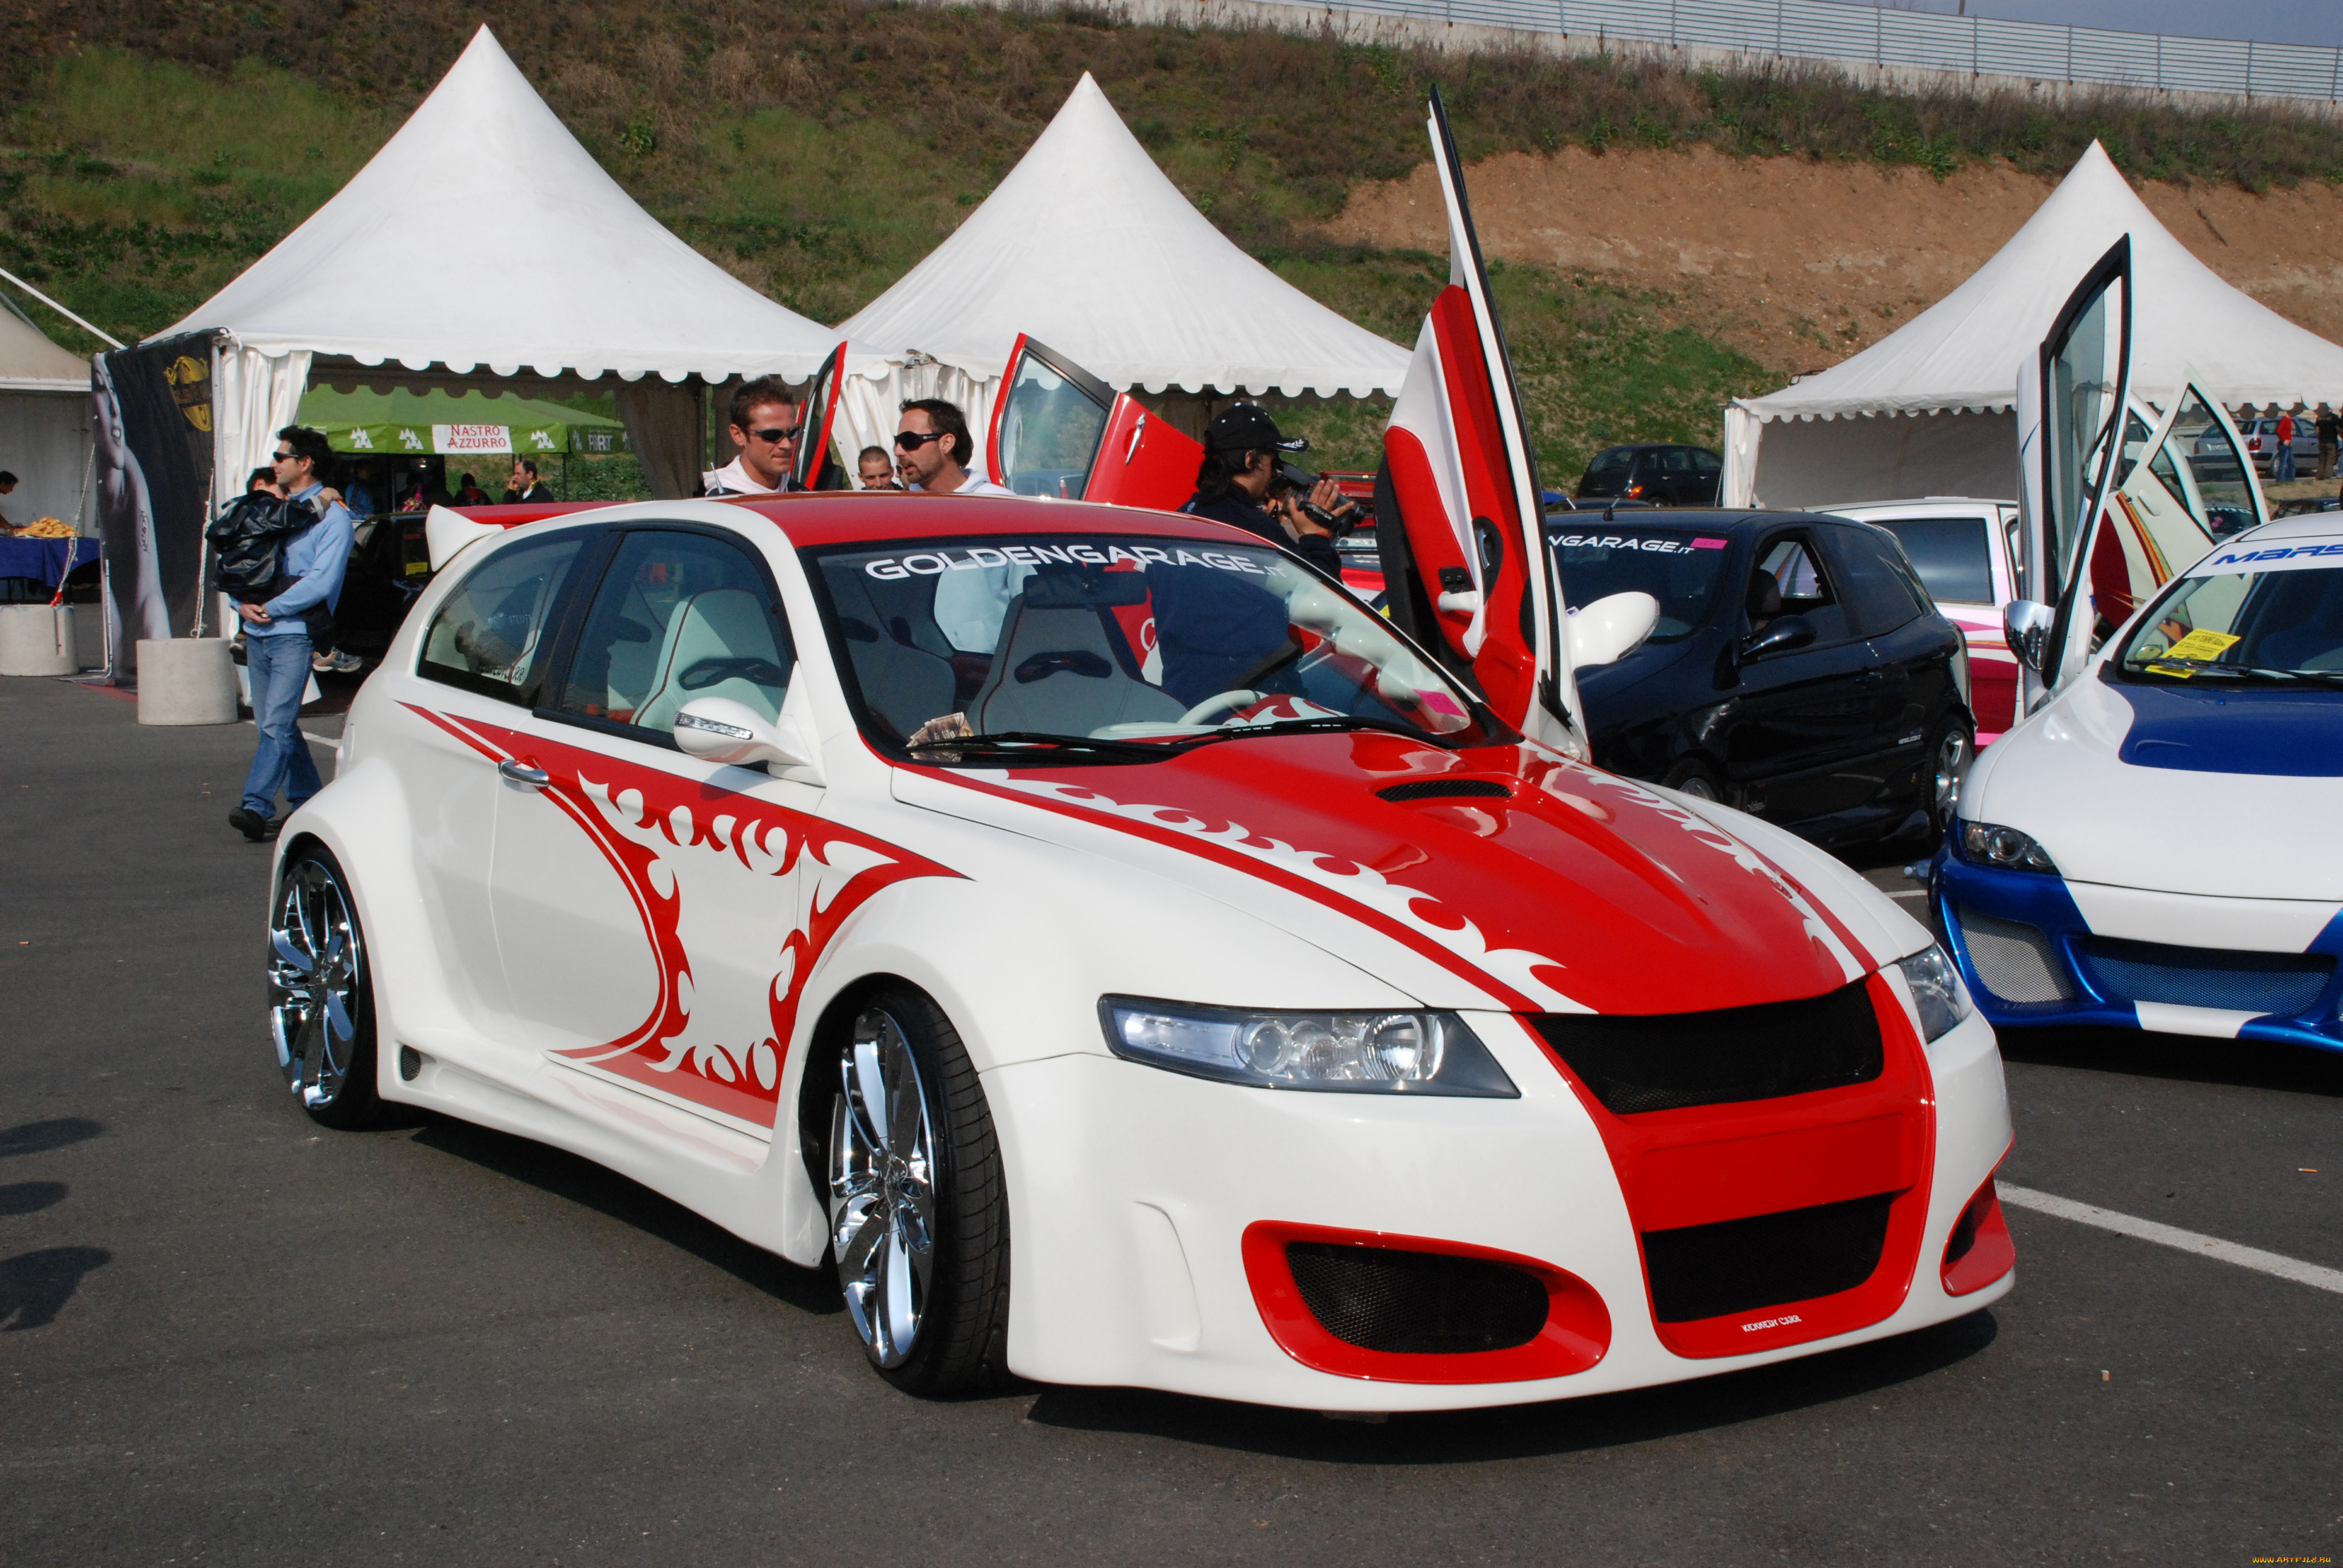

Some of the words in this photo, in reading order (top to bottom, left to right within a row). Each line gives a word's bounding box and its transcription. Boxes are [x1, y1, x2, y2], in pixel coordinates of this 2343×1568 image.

[451, 425, 500, 436] NASTRO
[447, 437, 506, 448] AZZURRO
[865, 545, 1288, 580] GOLDENGARAGE.IT
[1778, 1315, 1802, 1325] CARR
